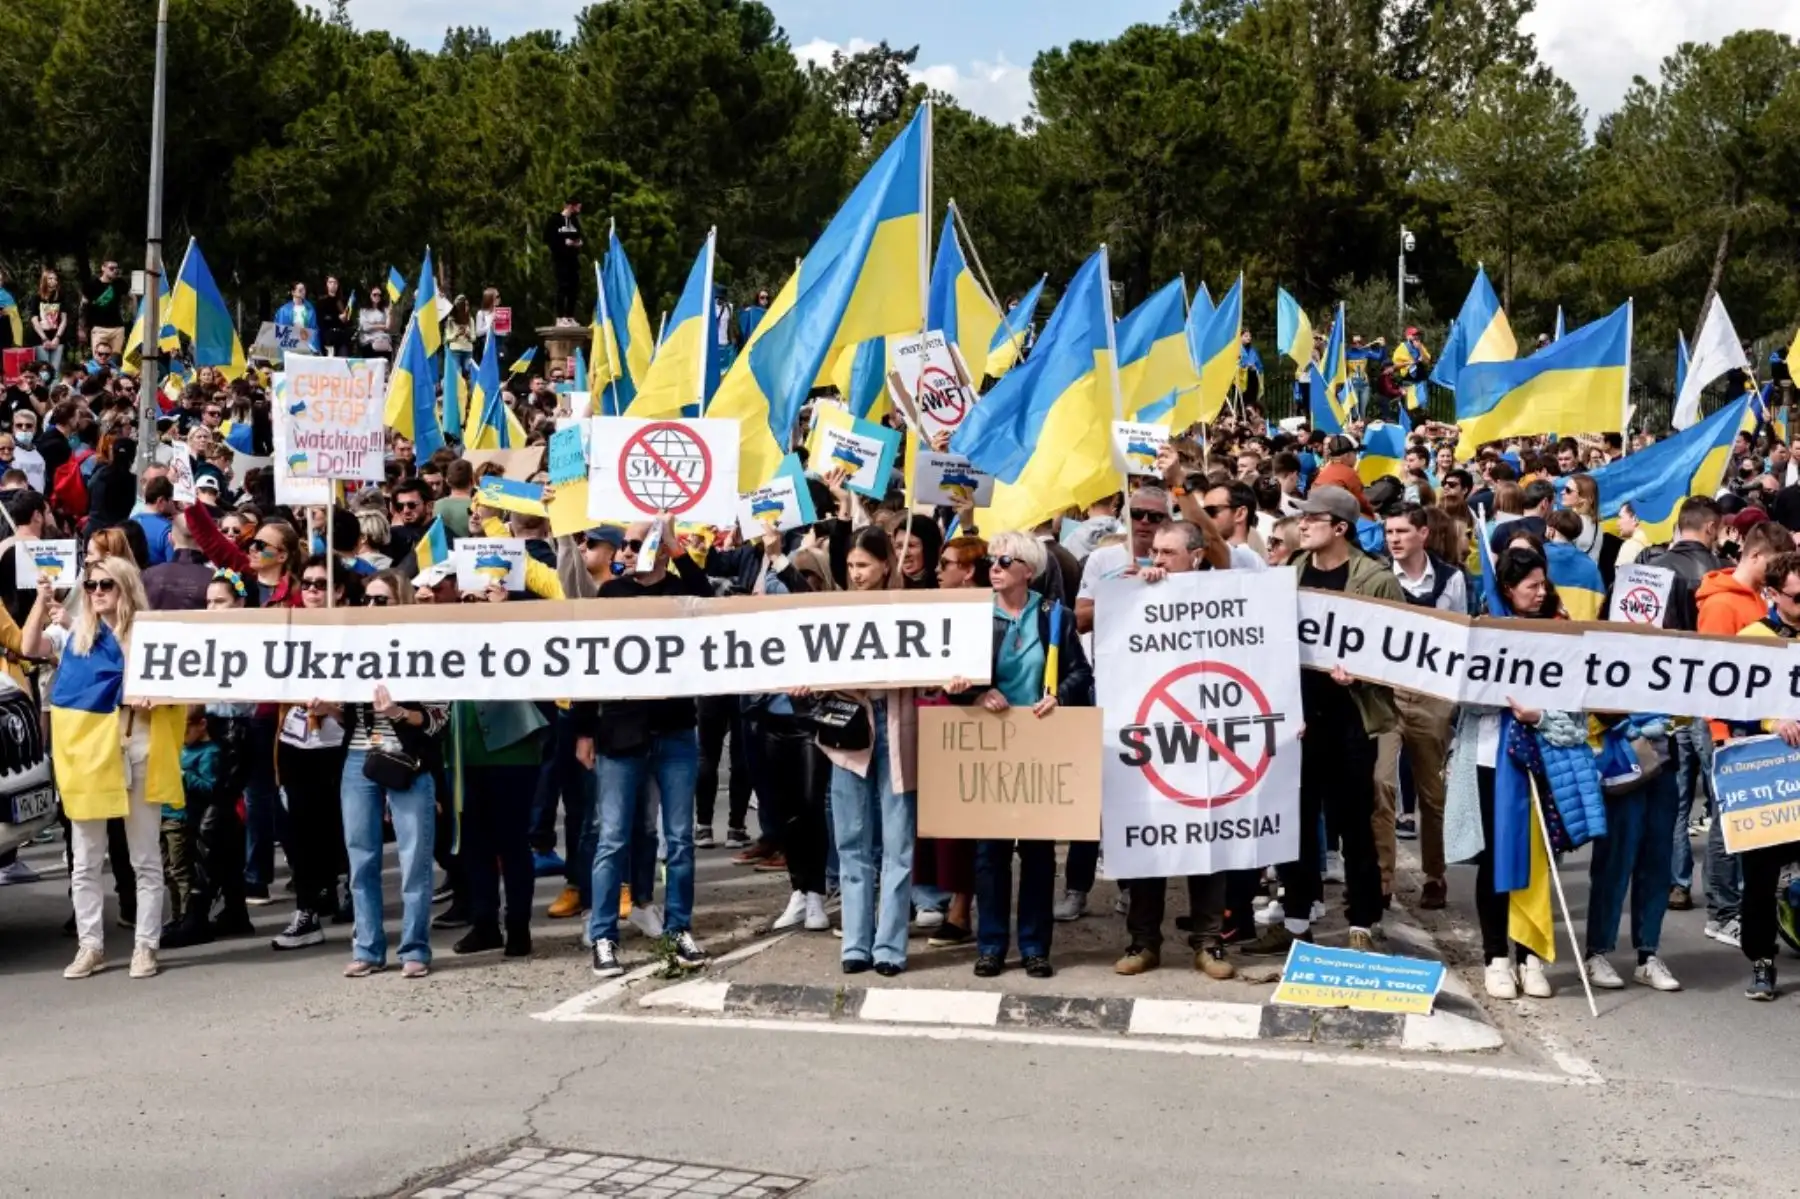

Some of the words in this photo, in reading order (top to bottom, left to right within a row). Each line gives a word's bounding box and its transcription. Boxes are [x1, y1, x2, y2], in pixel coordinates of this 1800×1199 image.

[293, 369, 373, 399] CYPRUS!
[310, 400, 365, 426] STOP
[628, 458, 702, 478] SWIFT
[1144, 598, 1248, 623] SUPPORT
[1619, 598, 1662, 614] SWIFT
[140, 639, 248, 688] Help
[264, 638, 465, 680] Ukraine
[479, 642, 531, 677] to
[544, 634, 685, 678] STOP
[700, 630, 786, 673] the
[798, 618, 952, 663] WAR!
[1129, 626, 1264, 653] SANCTIONS!
[1298, 611, 1365, 659] elp
[1382, 625, 1564, 689] Ukraine
[1584, 653, 1632, 688] to
[1647, 655, 1773, 699] STOP
[1199, 681, 1242, 709] NO
[942, 720, 1016, 751] HELP
[1119, 713, 1285, 767] SWIFT
[1725, 789, 1748, 807] με
[1751, 784, 1773, 801] τη
[1760, 804, 1800, 827] SWI
[1125, 824, 1178, 848] FOR
[1185, 813, 1281, 844] RUSSIA!
